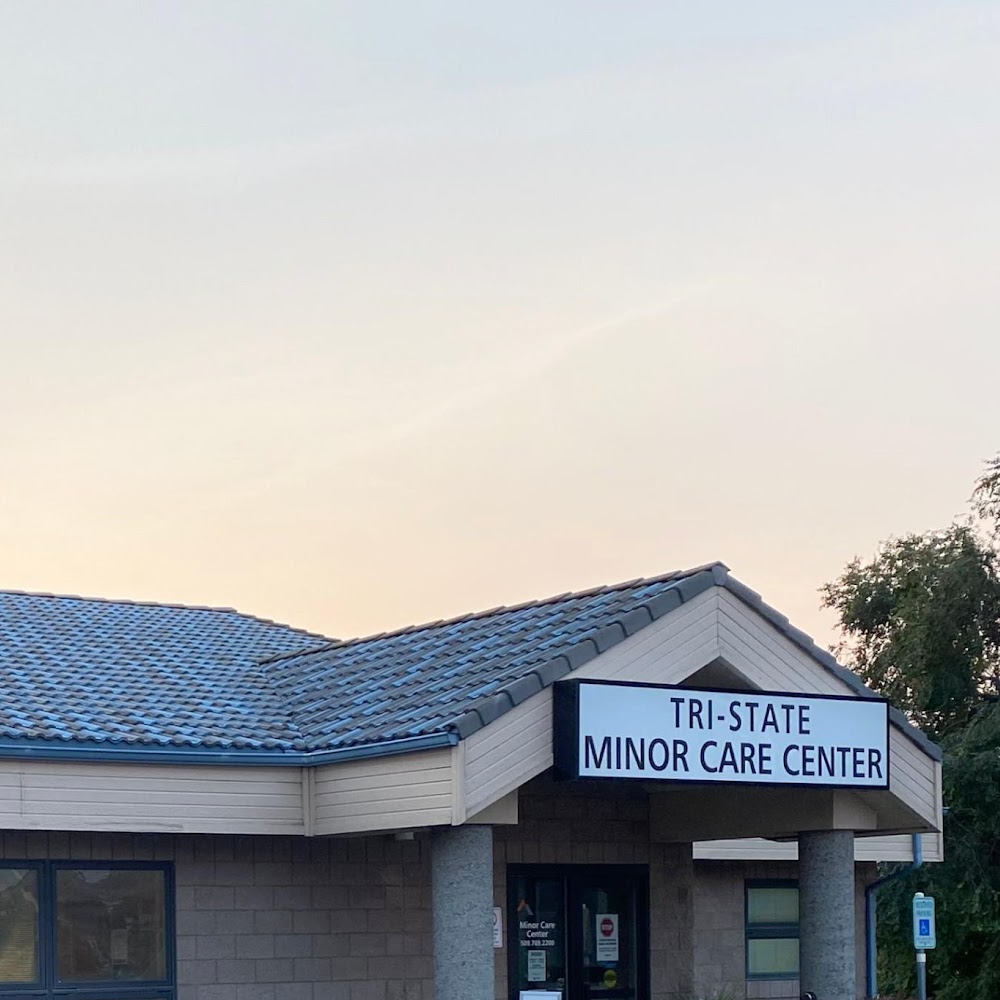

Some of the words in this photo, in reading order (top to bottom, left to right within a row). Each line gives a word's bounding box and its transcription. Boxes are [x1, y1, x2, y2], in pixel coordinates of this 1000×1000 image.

[670, 697, 811, 735] TRI-STATE
[584, 735, 690, 773] MINOR
[700, 740, 772, 775] CARE
[783, 744, 883, 779] CENTER
[520, 921, 539, 929] Minor
[540, 921, 555, 929] Care
[527, 930, 548, 938] Center
